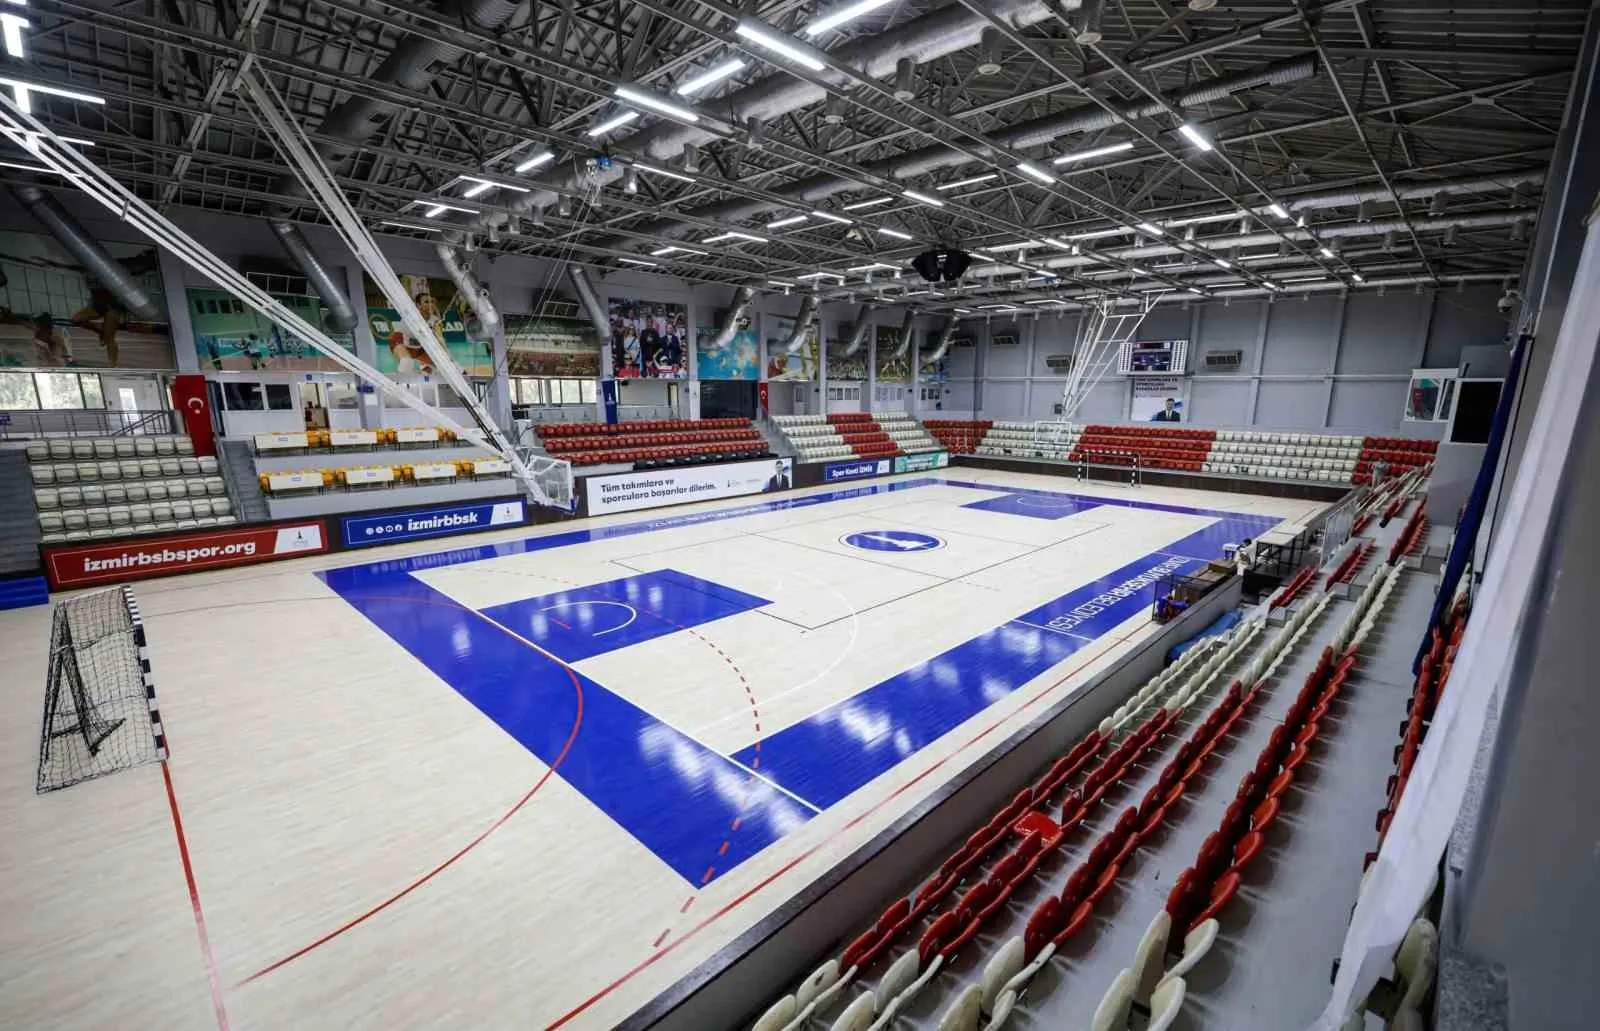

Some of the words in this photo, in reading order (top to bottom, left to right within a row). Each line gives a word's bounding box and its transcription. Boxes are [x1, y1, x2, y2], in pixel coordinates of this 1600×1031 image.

[601, 484, 620, 493] Tüm
[621, 480, 663, 491] takımlara
[602, 491, 649, 504] sporculara
[651, 486, 688, 499] başarılar
[689, 483, 717, 493] dilerim.
[408, 512, 478, 531] izmirbbsk
[84, 540, 256, 572] izmirbsbspor.org
